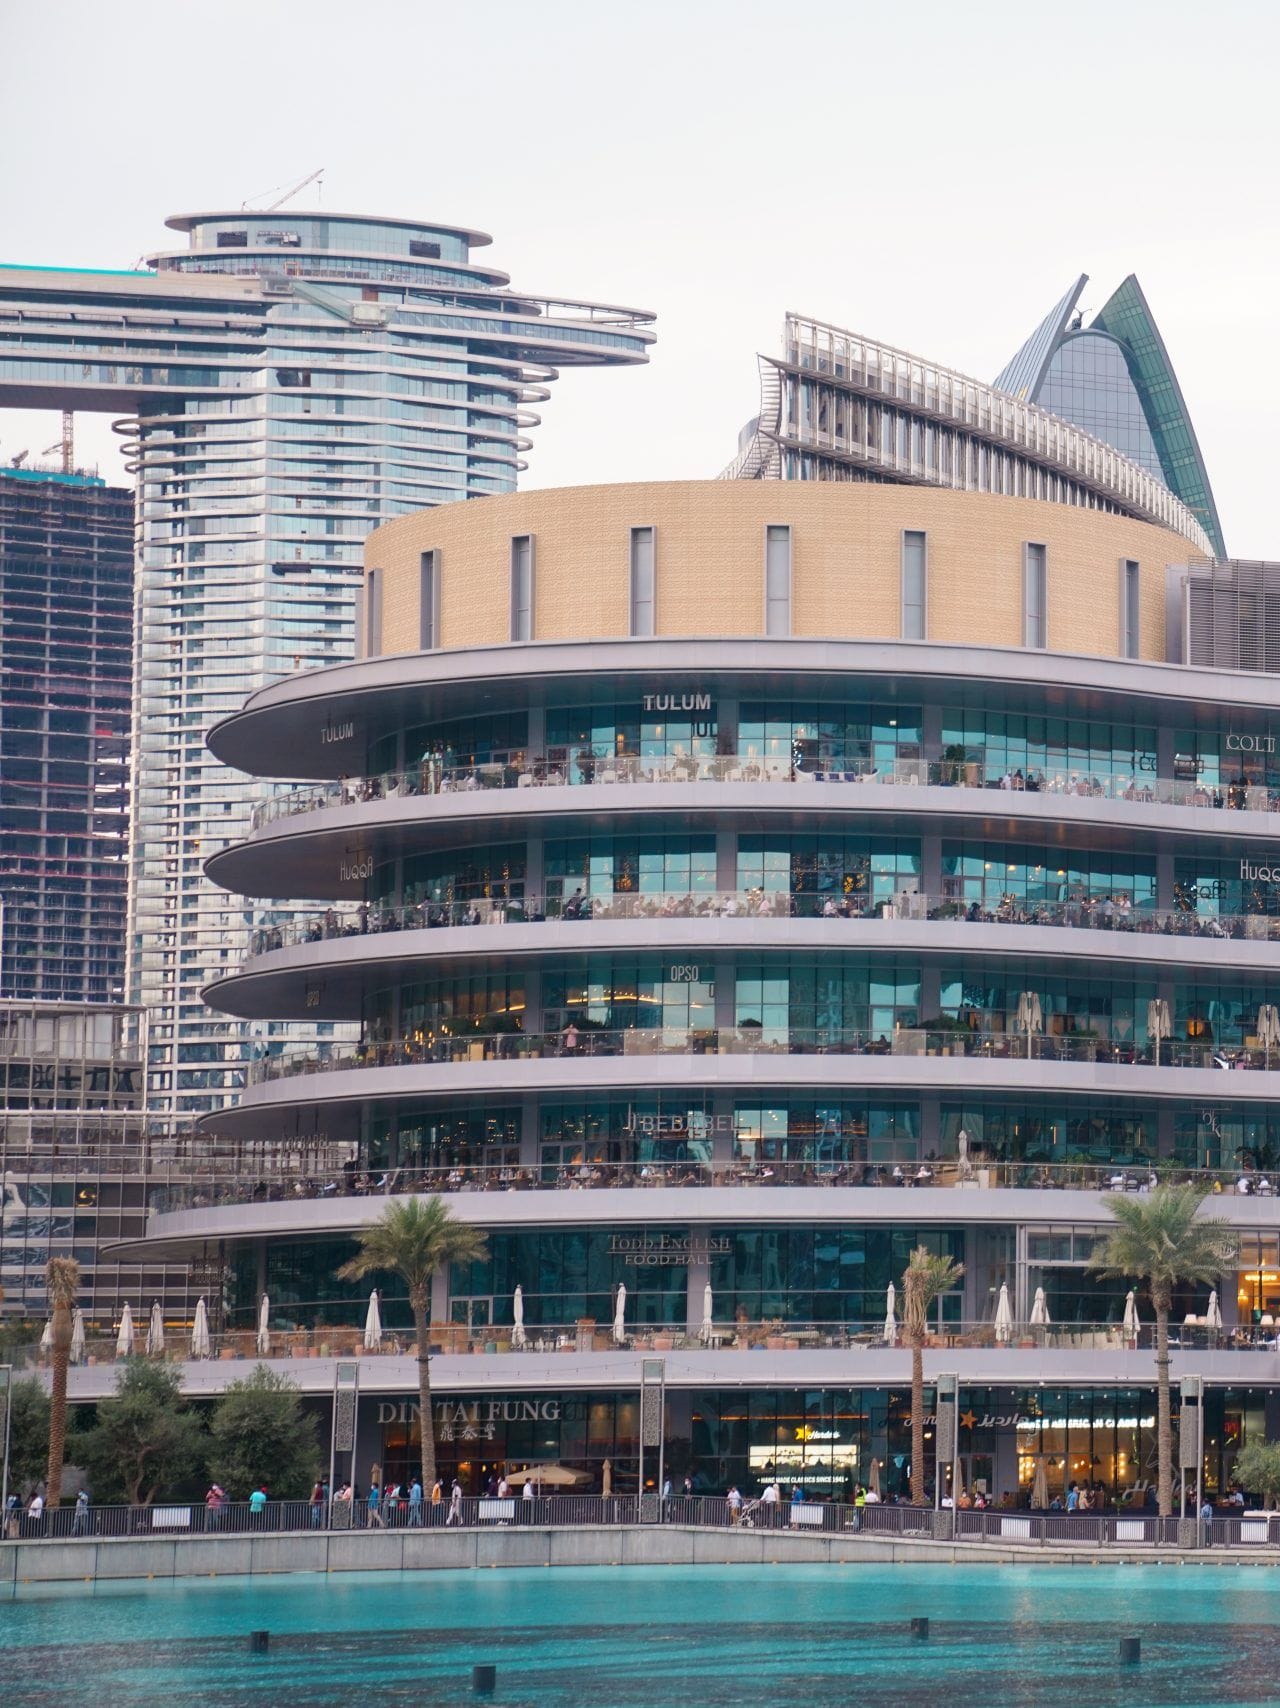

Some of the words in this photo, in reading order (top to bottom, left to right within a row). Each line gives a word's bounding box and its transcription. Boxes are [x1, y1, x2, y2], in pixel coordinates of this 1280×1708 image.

[643, 694, 711, 710] TULUM
[320, 722, 353, 744] TULUM
[670, 965, 699, 982] OPSO
[625, 1254, 670, 1265] FOOD
[675, 1254, 713, 1265] HALL
[488, 1399, 561, 1421] FUNG
